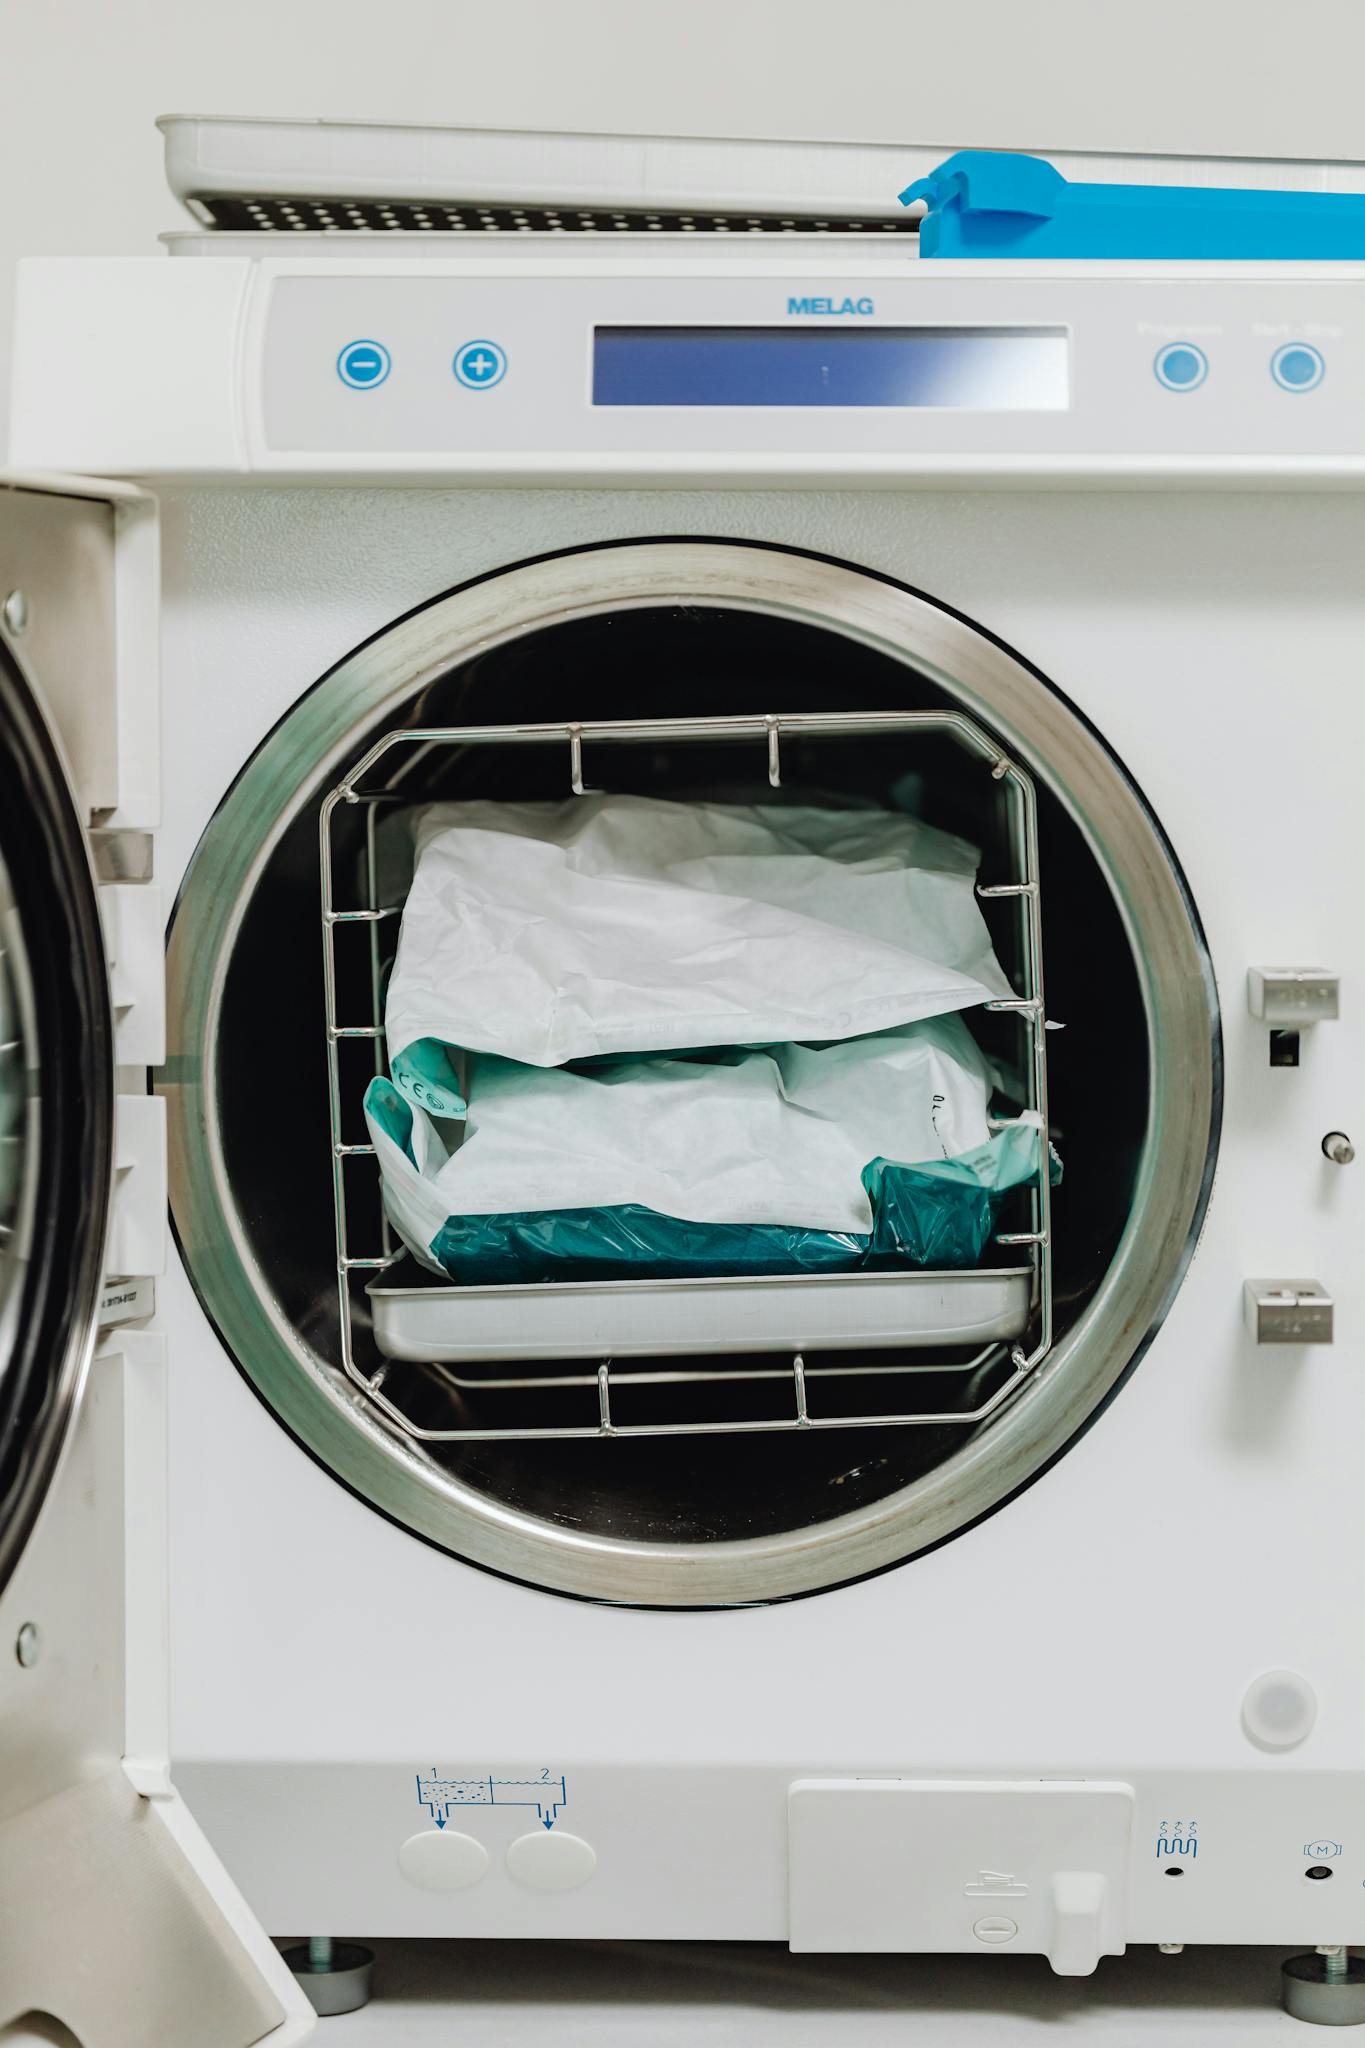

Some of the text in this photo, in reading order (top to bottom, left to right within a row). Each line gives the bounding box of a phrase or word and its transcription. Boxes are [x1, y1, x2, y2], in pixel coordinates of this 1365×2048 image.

[787, 297, 874, 315] MELAG
[431, 1767, 437, 1779] 1
[540, 1768, 550, 1780] 2
[1316, 1846, 1328, 1855] M
